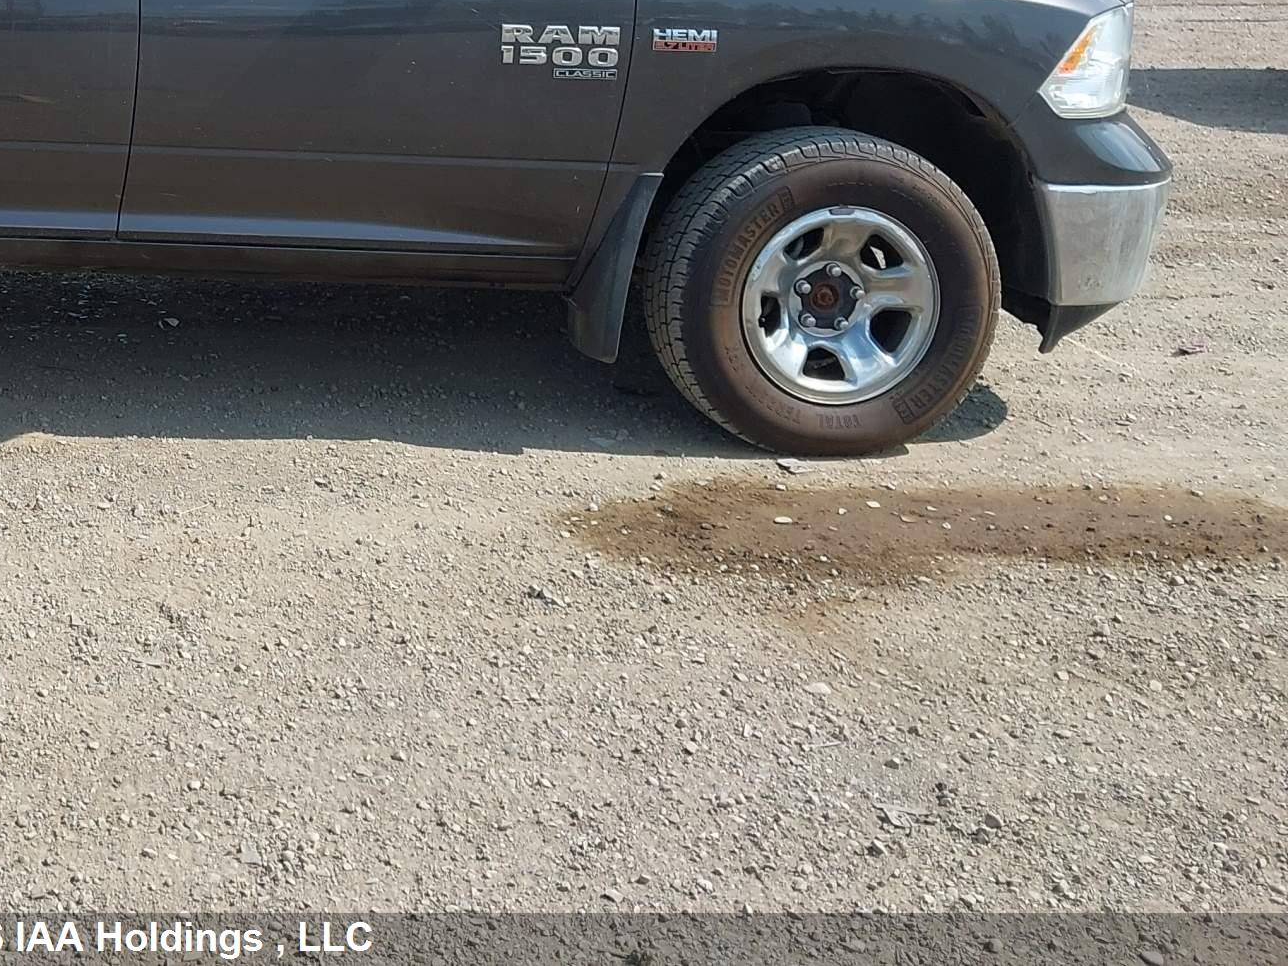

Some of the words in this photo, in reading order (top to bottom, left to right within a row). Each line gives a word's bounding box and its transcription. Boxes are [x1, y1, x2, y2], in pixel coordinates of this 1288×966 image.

[501, 23, 621, 45] RAM
[653, 28, 718, 42] HEMI
[500, 44, 619, 68] 1500
[554, 68, 618, 79] CLASSIC
